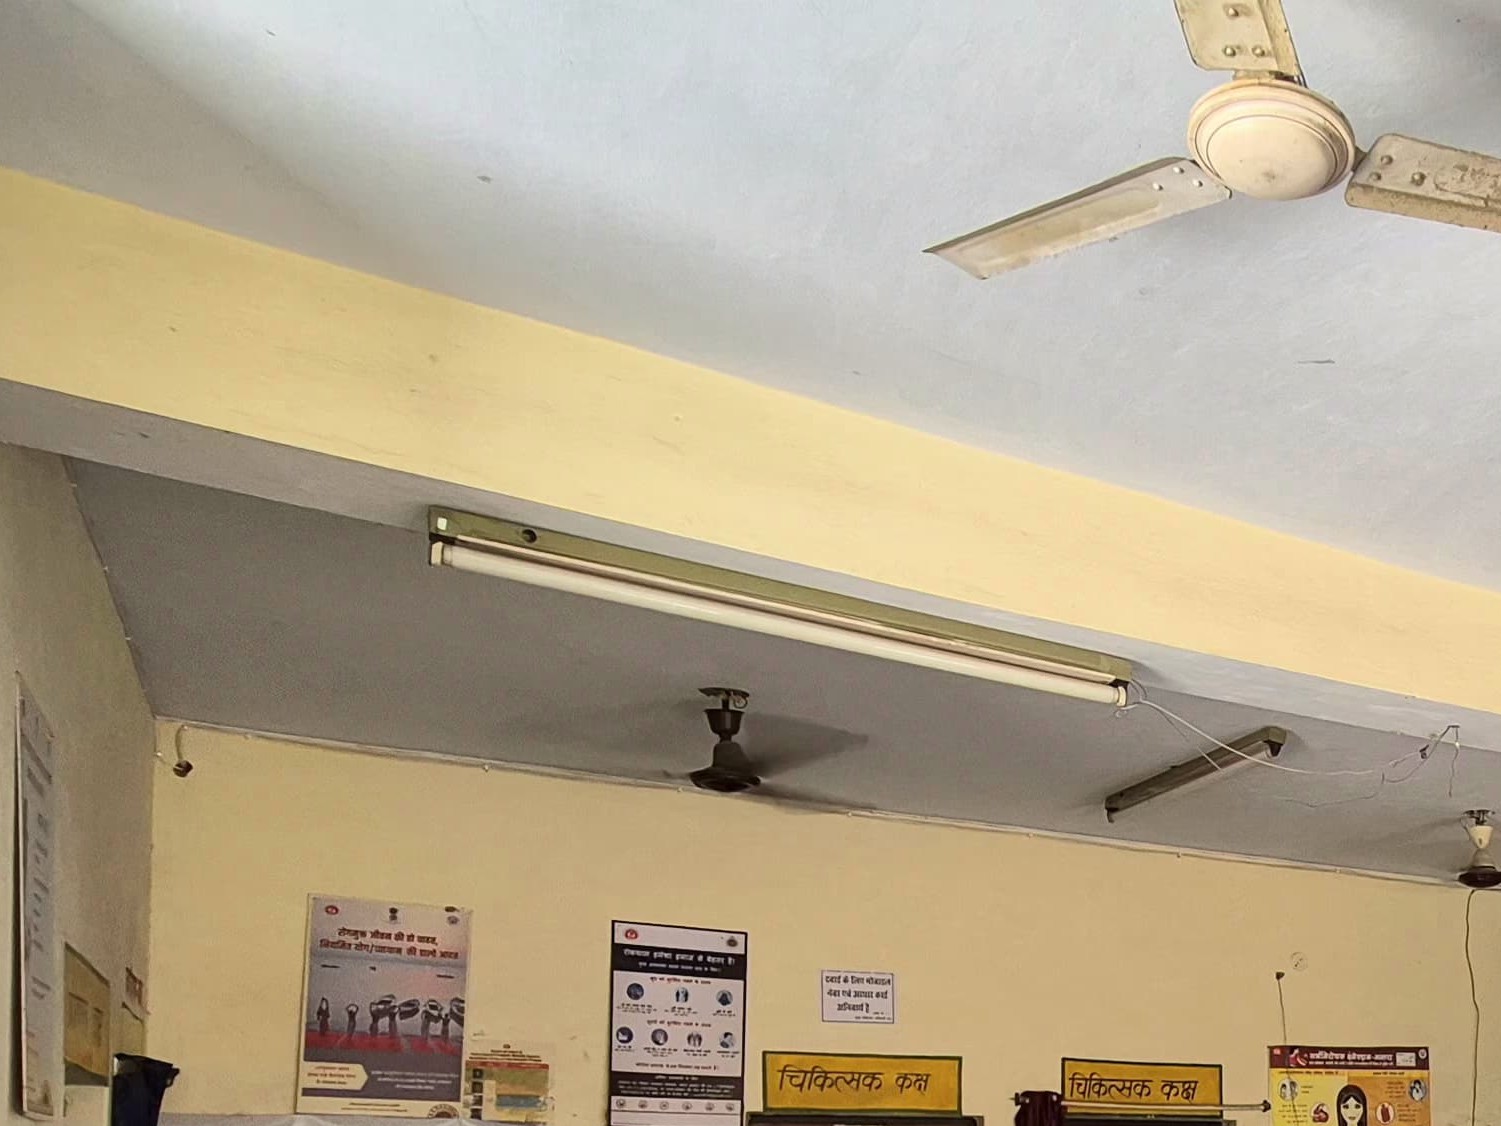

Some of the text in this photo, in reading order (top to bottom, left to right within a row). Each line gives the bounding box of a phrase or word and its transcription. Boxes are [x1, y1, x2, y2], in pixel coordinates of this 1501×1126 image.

[777, 1063, 931, 1097] चिकित्सक कक्ष
[1068, 1072, 1199, 1103] चिकित्सक कक्ष
